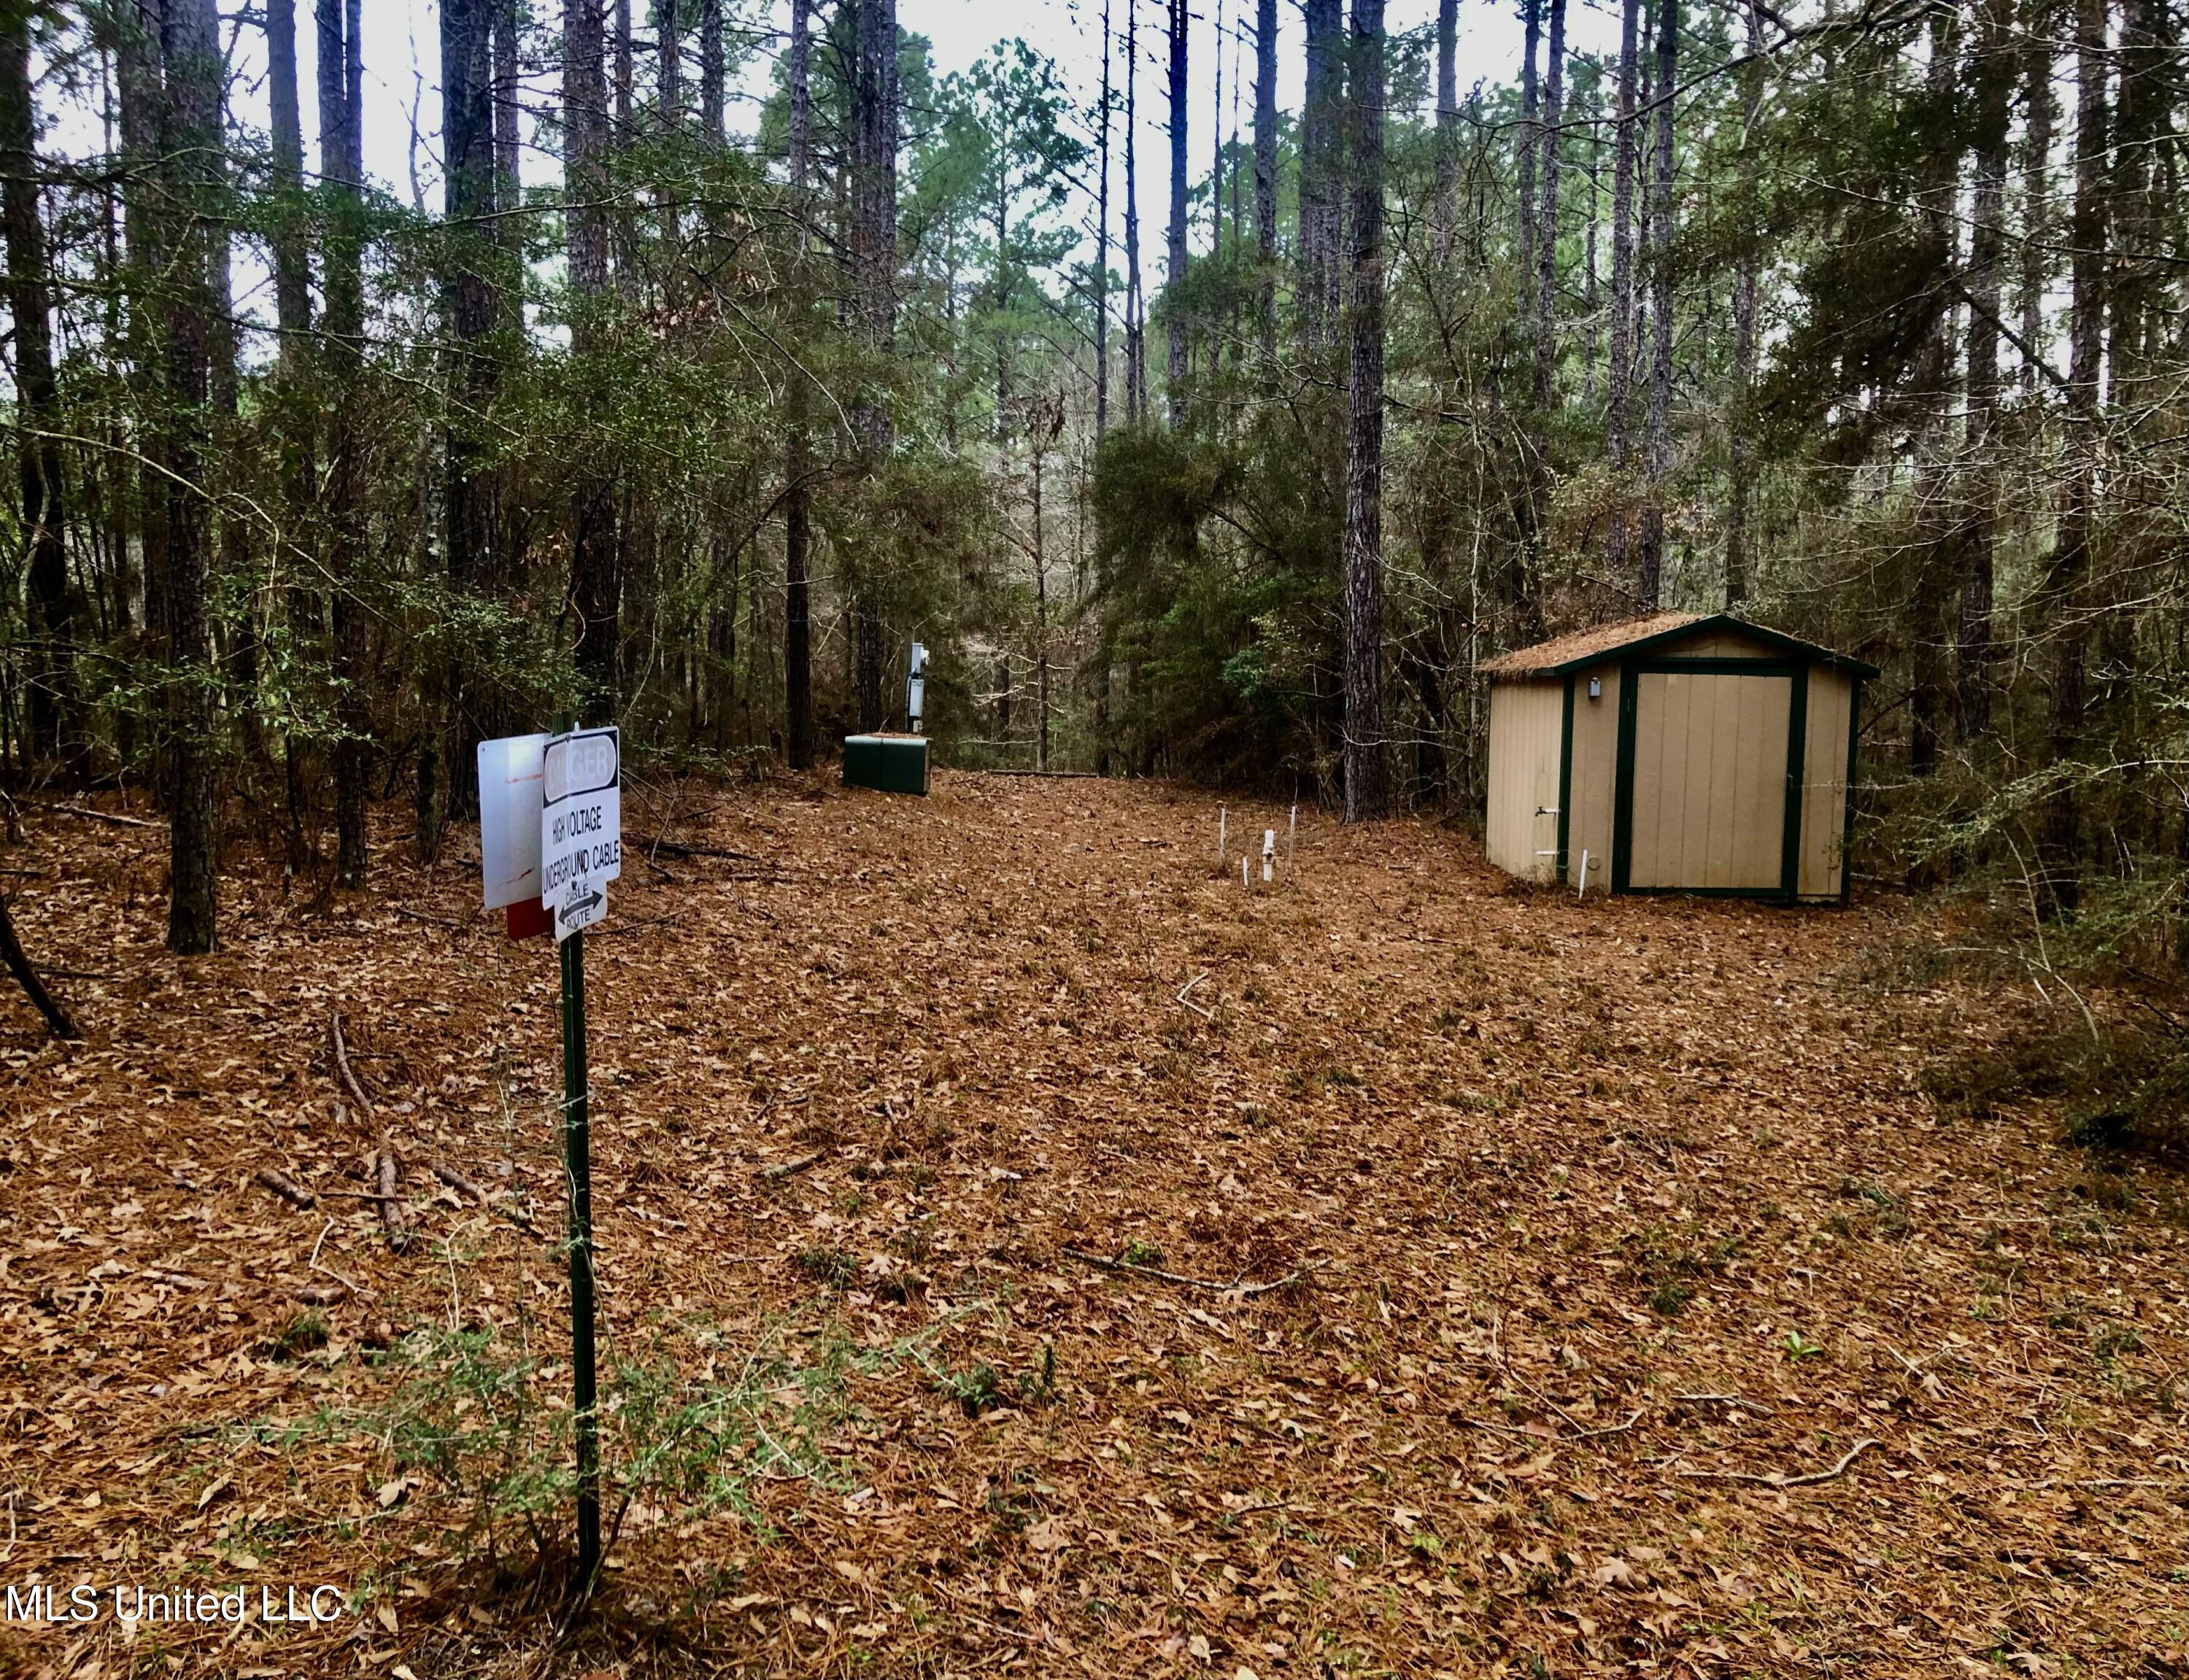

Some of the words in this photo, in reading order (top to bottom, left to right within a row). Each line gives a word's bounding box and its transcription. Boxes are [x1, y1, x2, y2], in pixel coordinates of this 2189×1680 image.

[552, 816, 566, 845] HIGH
[566, 805, 602, 838] VOLTAGE
[543, 848, 590, 894] UNDERGROUND
[592, 840, 619, 870] CABLE
[565, 883, 589, 905] CABLE
[566, 908, 591, 932] ROUTE
